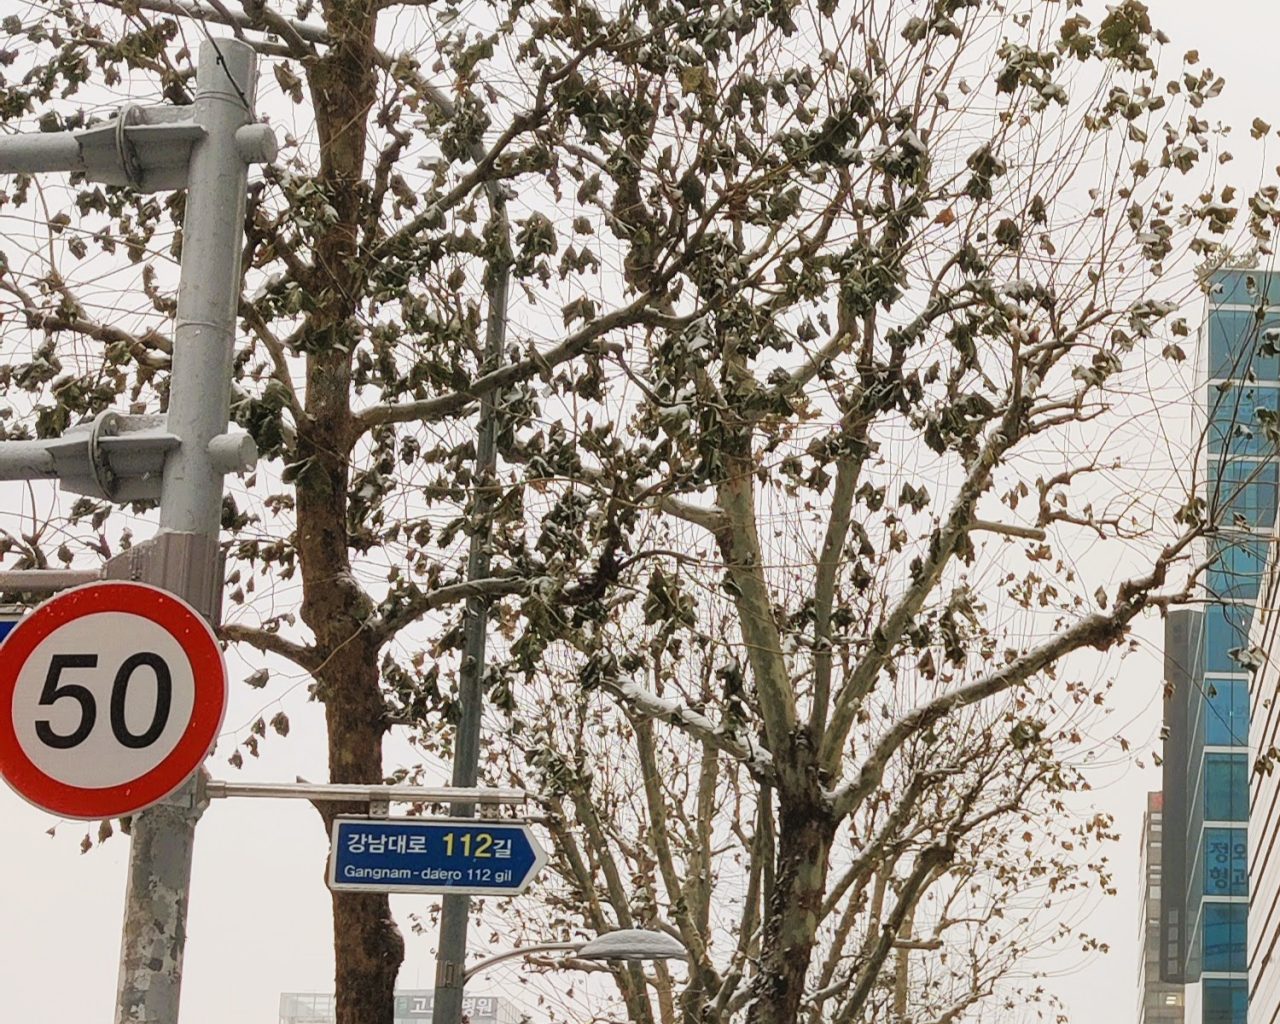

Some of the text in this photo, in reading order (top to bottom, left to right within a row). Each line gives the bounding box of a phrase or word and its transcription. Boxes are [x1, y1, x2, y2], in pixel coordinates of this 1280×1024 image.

[35, 652, 172, 749] 50
[347, 832, 512, 859] 강남대로 112길
[467, 868, 491, 881] 112
[495, 867, 512, 884] gil
